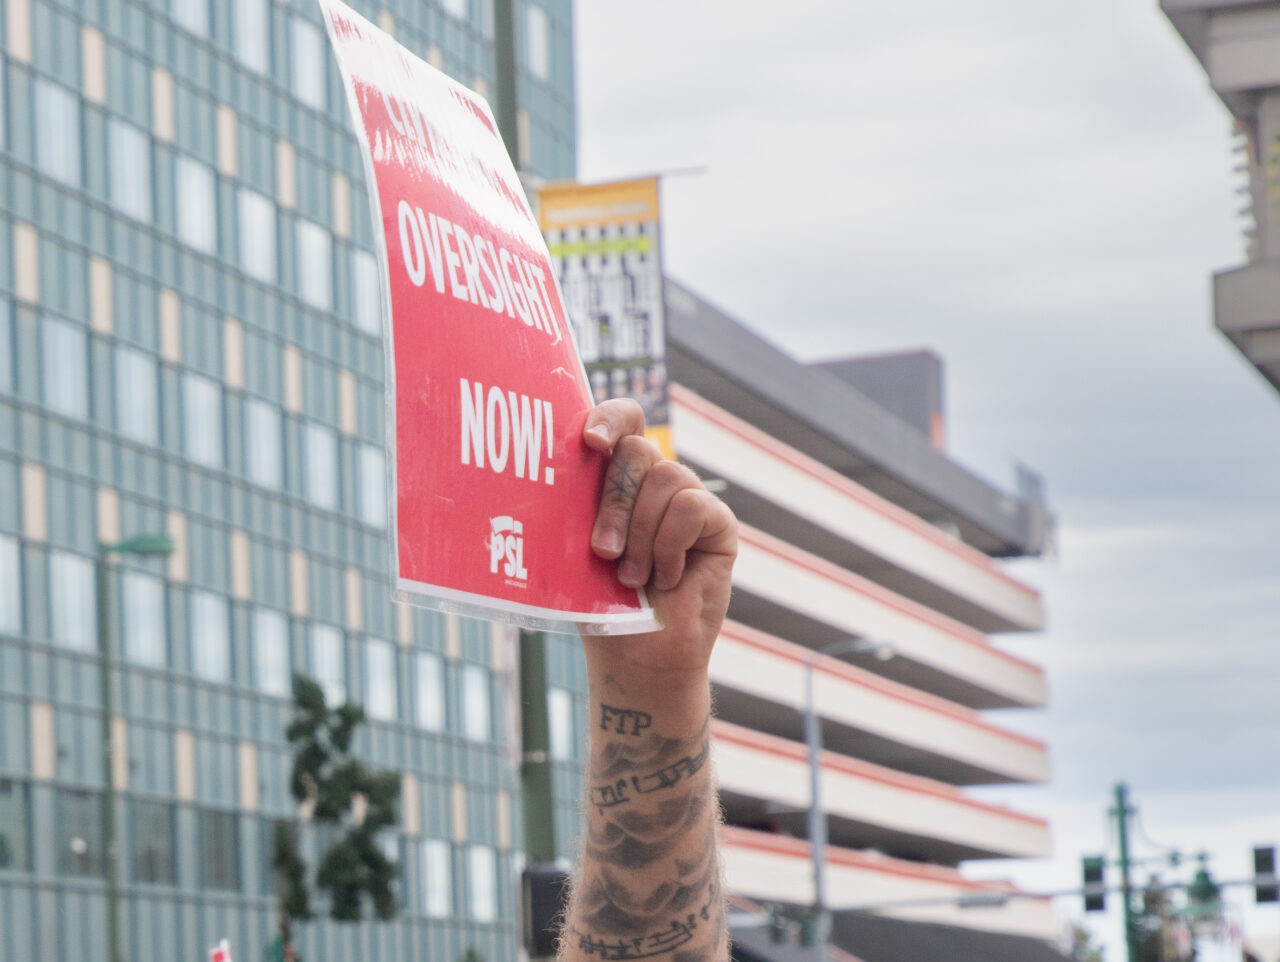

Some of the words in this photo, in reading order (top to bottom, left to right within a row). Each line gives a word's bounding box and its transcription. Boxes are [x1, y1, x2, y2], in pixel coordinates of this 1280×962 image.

[397, 199, 562, 341] OVERSIGHT
[460, 377, 555, 486] NOW!
[490, 531, 528, 580] PSL
[601, 704, 652, 735] FTP
